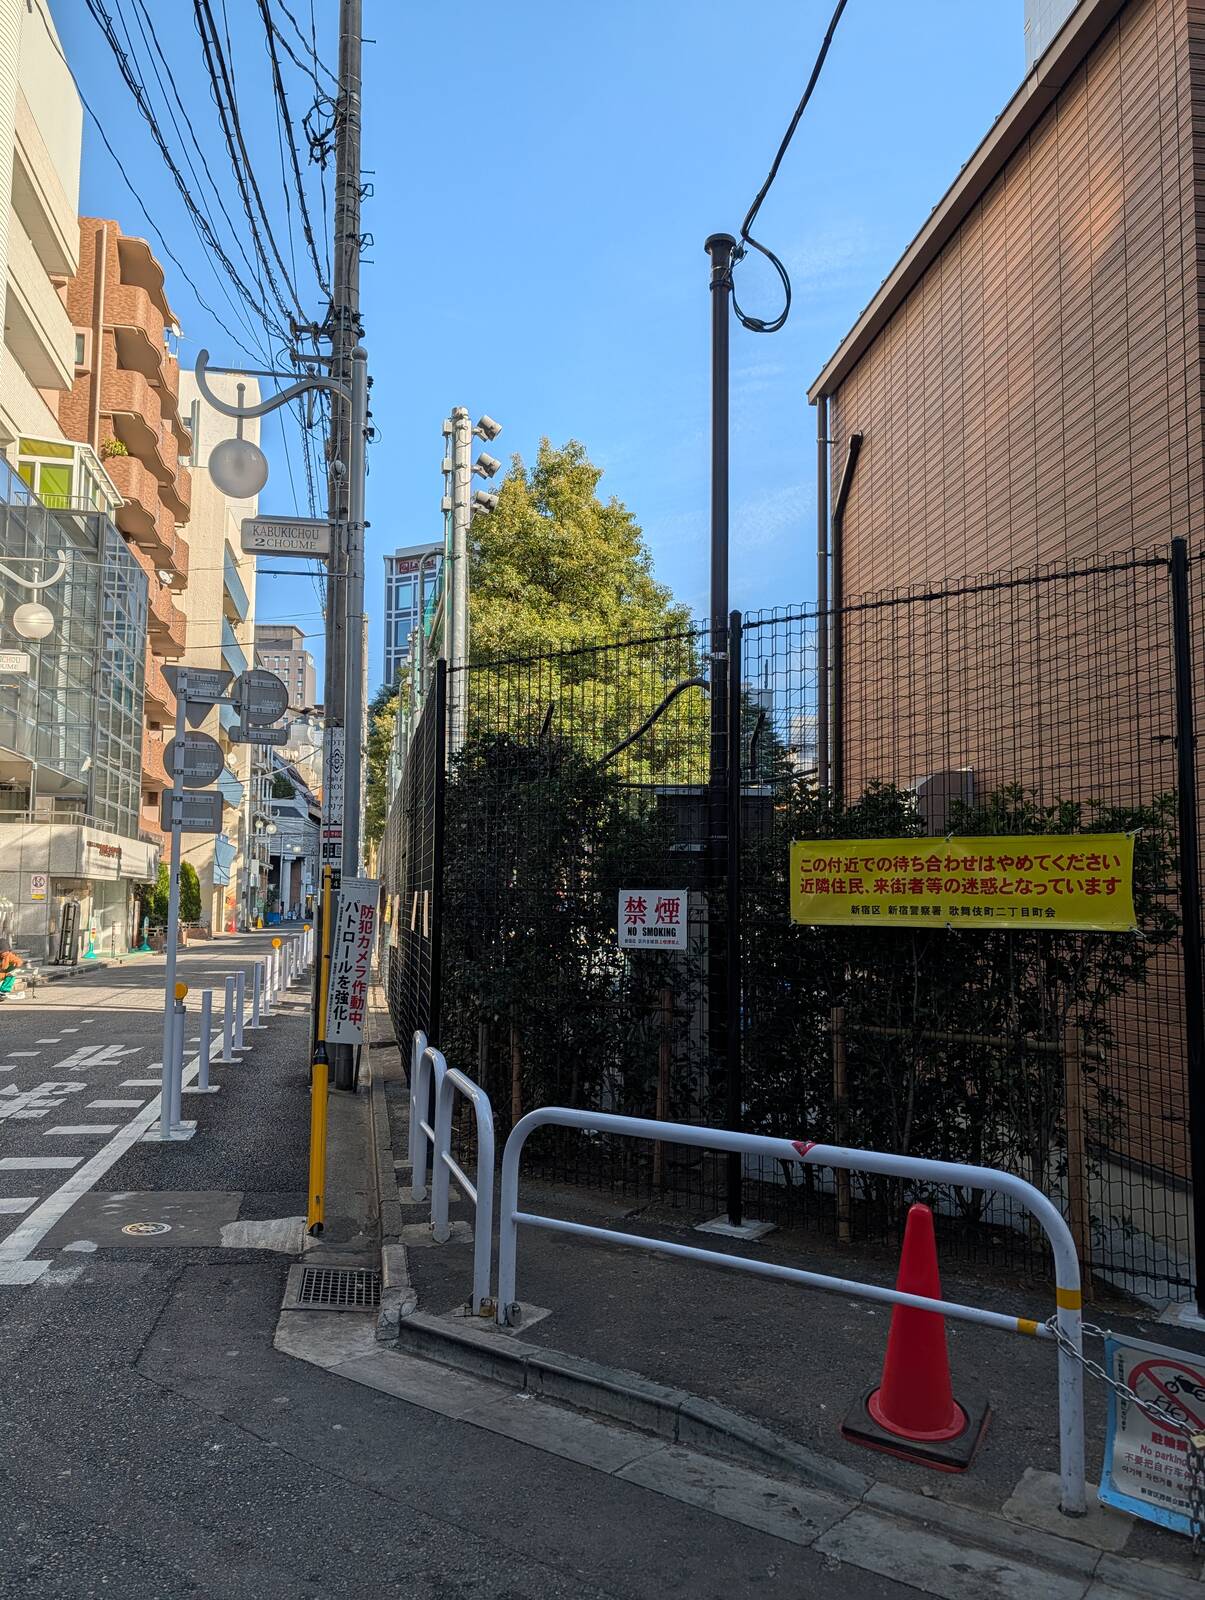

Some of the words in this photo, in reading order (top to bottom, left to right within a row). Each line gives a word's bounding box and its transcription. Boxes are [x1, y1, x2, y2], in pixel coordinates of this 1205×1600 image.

[252, 525, 319, 540] KABUKICHOU
[800, 853, 1121, 874] この付近での待ち合わせはやめてください
[800, 877, 1122, 895] 近隣住民、来街者等の迷惑となっています
[624, 896, 681, 925] 禁煙
[850, 905, 881, 915] 新宿区
[627, 927, 638, 936] NO
[642, 927, 677, 937] SMOKING
[348, 904, 375, 1032] 防犯カメラ作動中、
[1140, 1444, 1153, 1456] No
[1152, 1432, 1189, 1452] 駐輪禁
